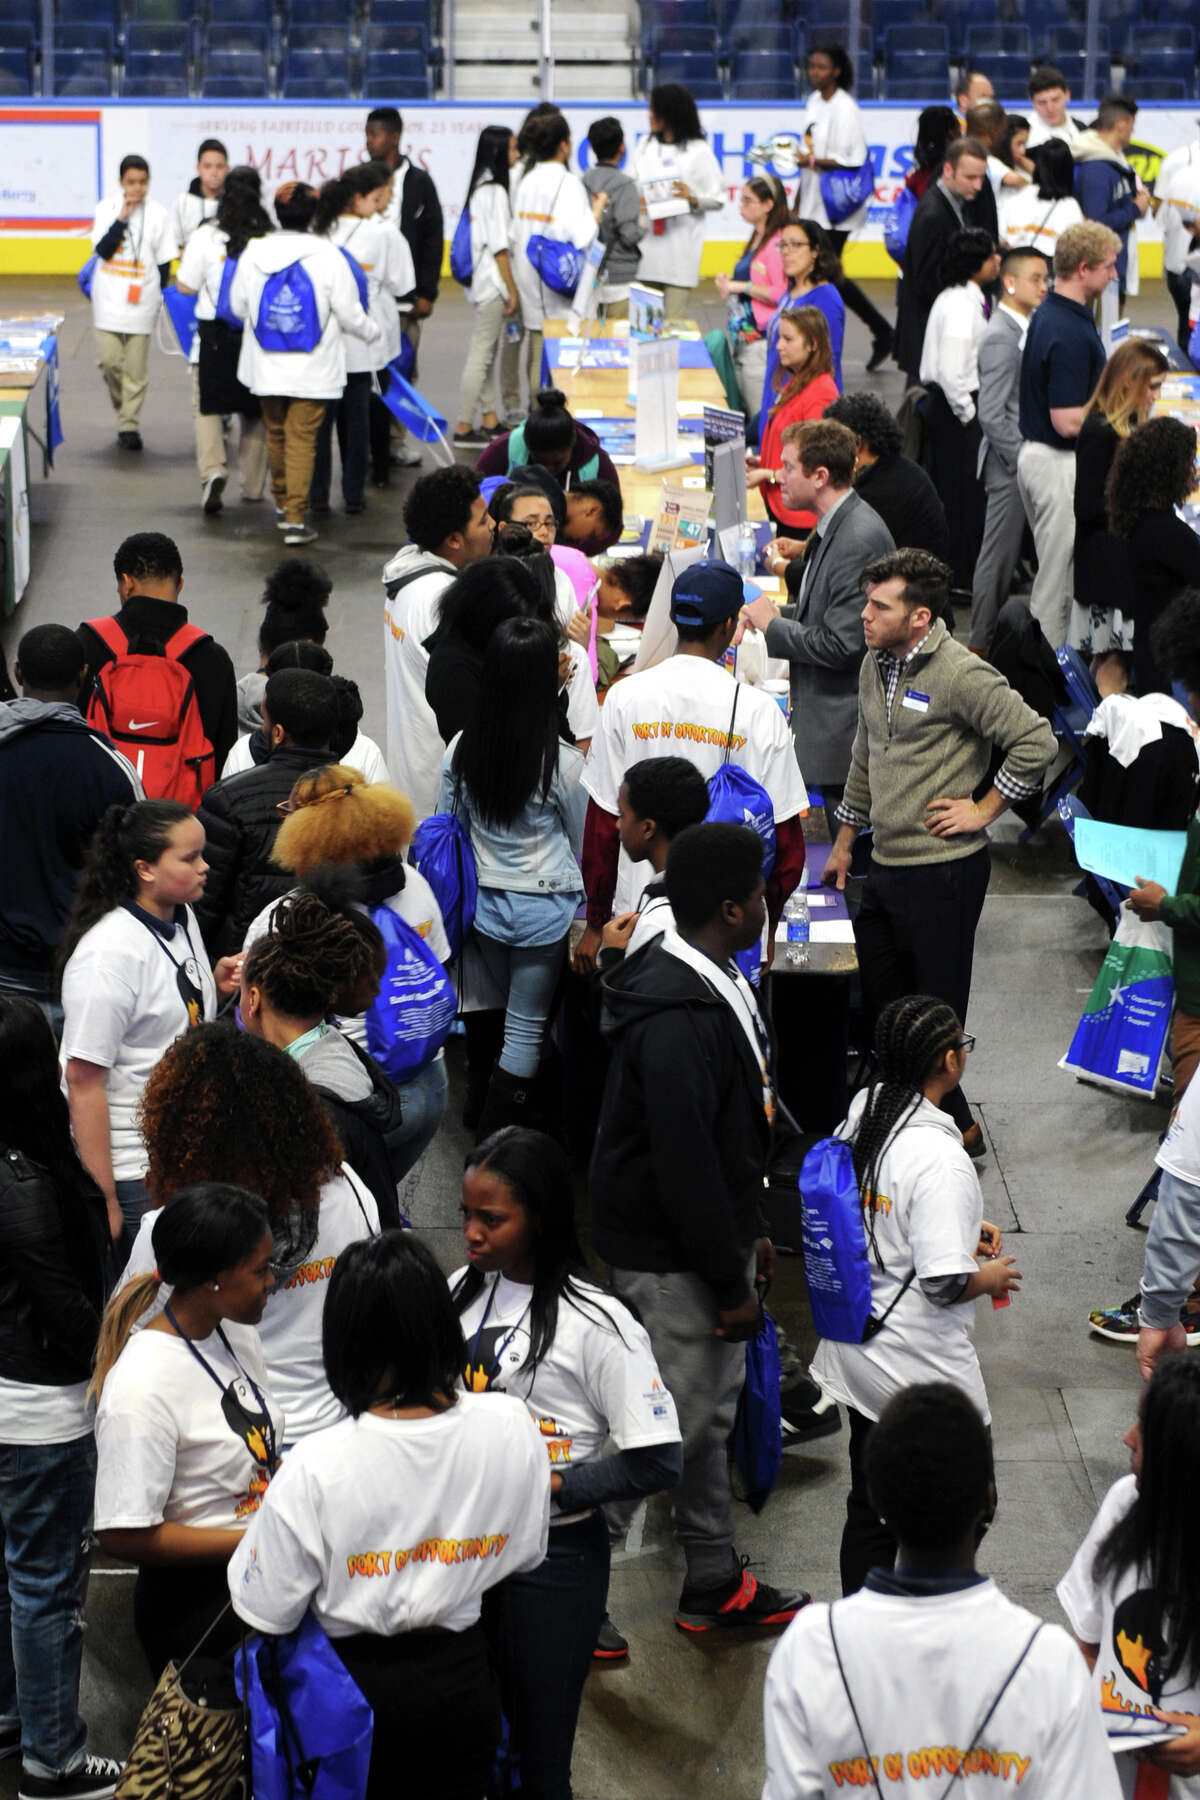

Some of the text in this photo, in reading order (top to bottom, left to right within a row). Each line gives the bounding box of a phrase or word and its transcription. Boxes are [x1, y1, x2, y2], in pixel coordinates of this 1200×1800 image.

[674, 722, 747, 751] OPPORTUNTY
[346, 1551, 392, 1578] PORT
[829, 1756, 880, 1788] PORT
[907, 1745, 1032, 1785] OPPOTUNITY
